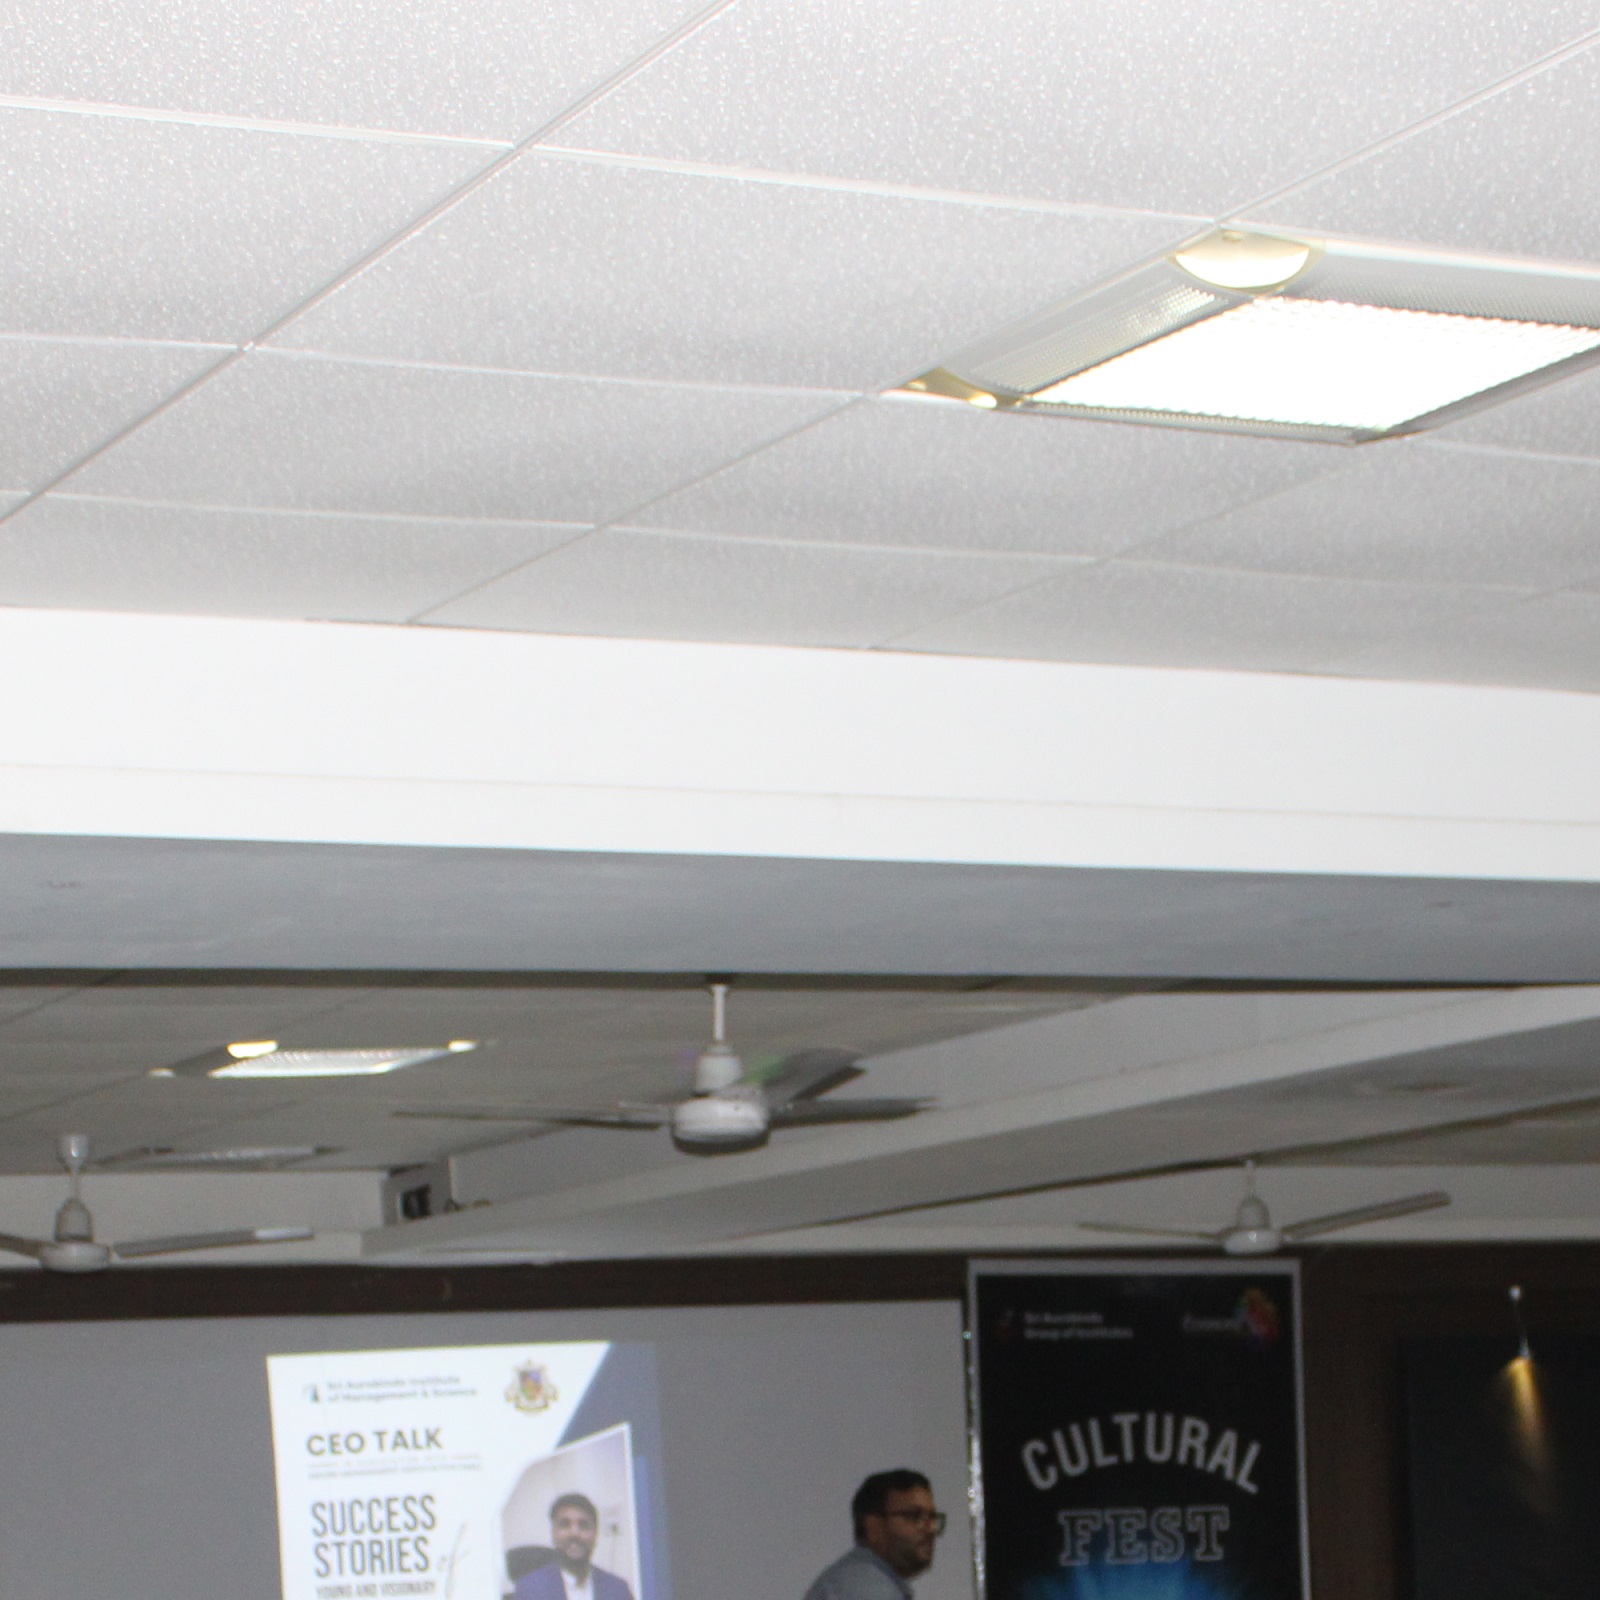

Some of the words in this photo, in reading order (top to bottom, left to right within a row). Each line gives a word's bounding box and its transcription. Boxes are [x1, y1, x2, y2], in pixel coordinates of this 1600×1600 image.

[306, 1431, 366, 1456] CEO
[372, 1427, 443, 1452] TALK
[1021, 1411, 1261, 1495] CULTURAL
[311, 1494, 437, 1537] SUCCESS
[1058, 1505, 1231, 1567] FEST
[314, 1535, 431, 1578] STORIES
